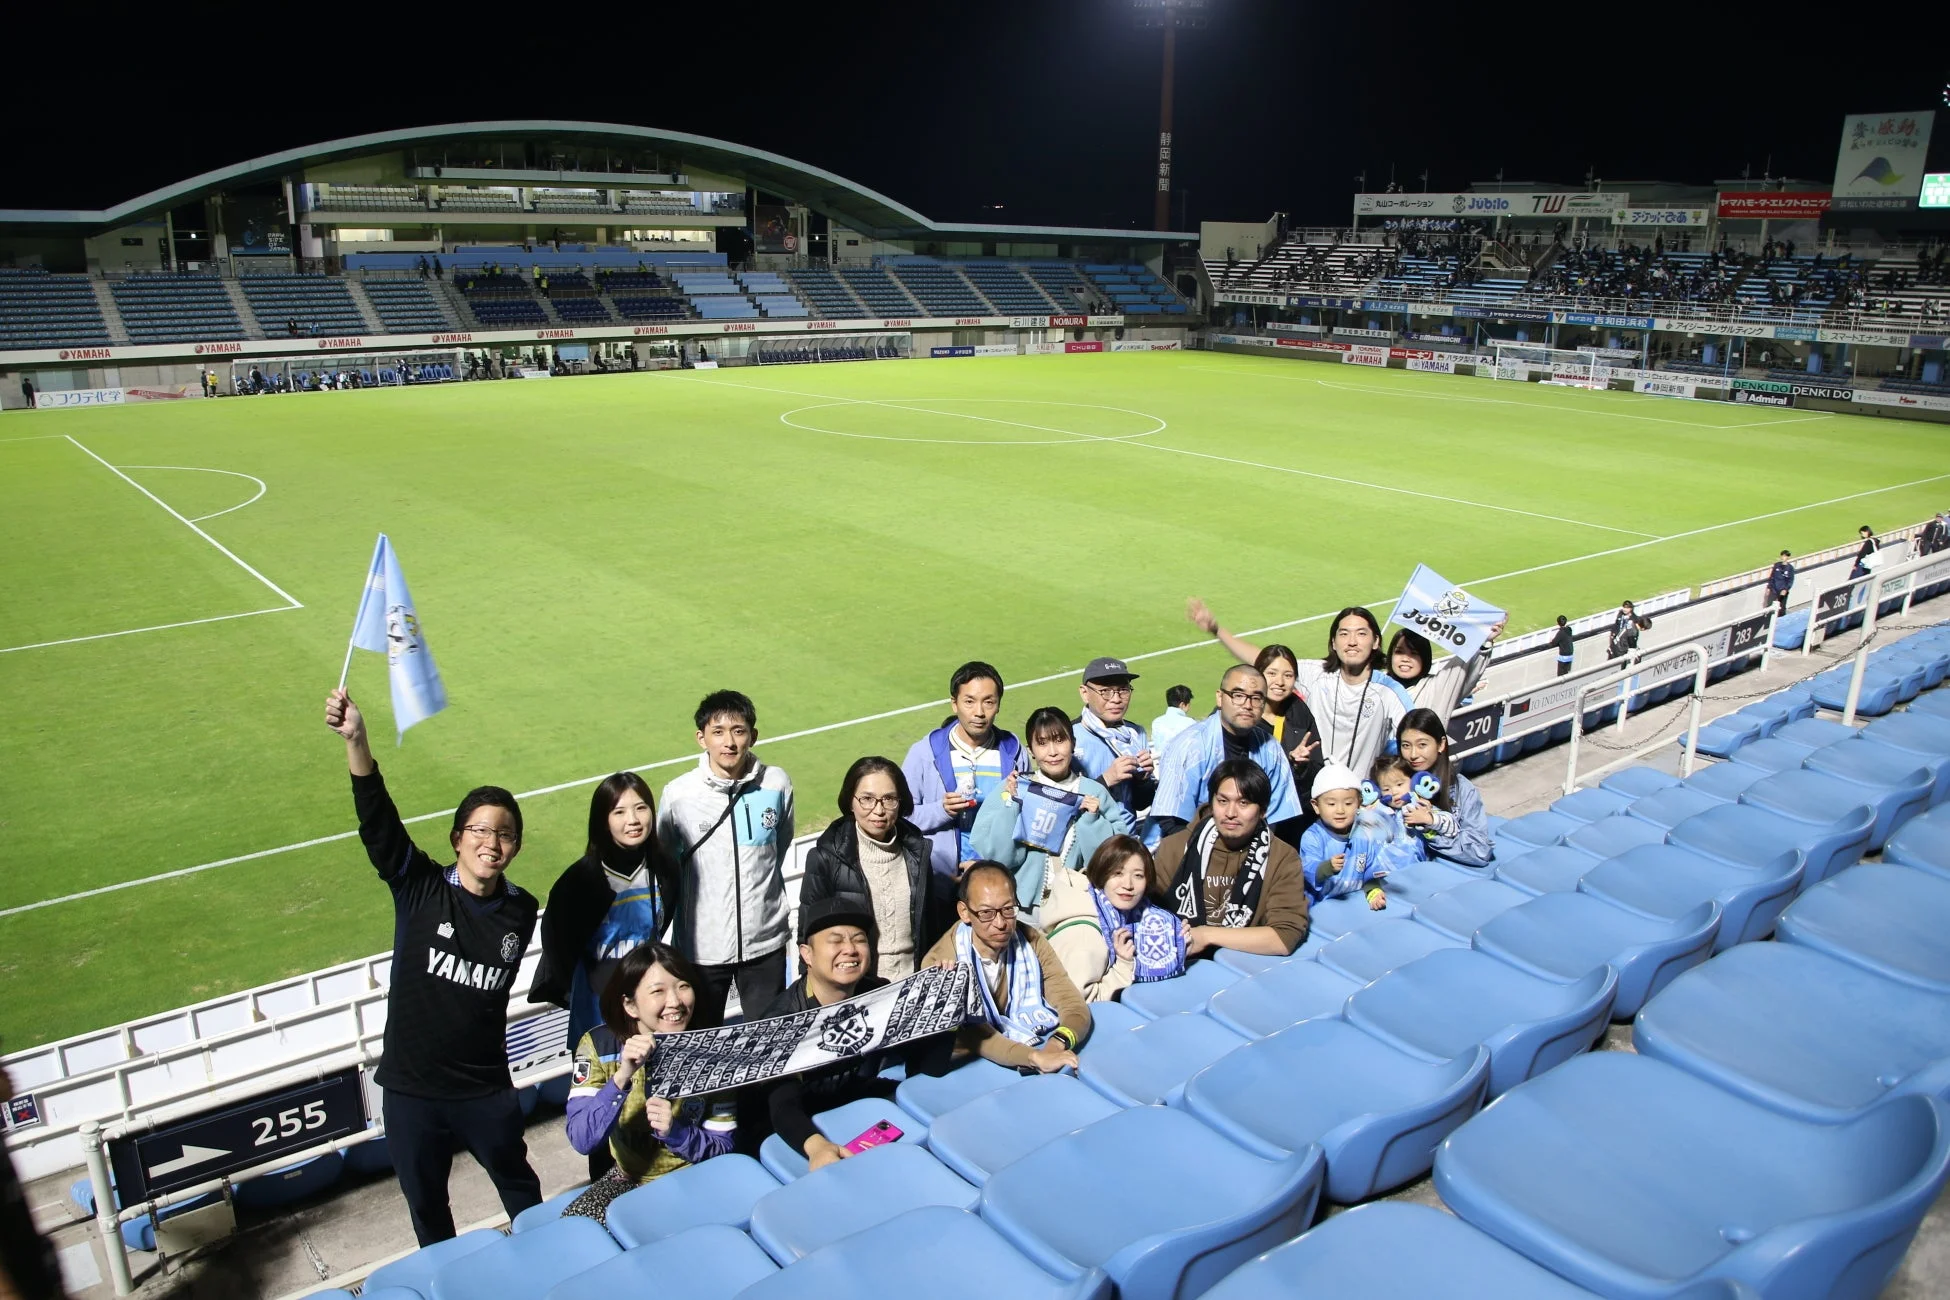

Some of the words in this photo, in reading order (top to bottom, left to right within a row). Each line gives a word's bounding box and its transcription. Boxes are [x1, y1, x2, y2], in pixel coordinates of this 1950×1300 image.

[1158, 132, 1172, 192] 静岡新聞
[1376, 200, 1434, 208] 丸山コーポレーション
[1632, 211, 1688, 224] チケットぴあ
[730, 322, 755, 331] YAMAHA
[813, 321, 837, 329] YAMAHA
[889, 319, 912, 327] YAMAHA
[960, 318, 981, 326] YAMAHA
[1053, 317, 1084, 326] NOMURA
[545, 329, 574, 338] YAMAHA
[640, 325, 668, 335] YAMAHA
[1675, 322, 1765, 335] アイジーコンサルティング
[327, 338, 362, 348] YAMAHA
[440, 333, 473, 343] YAMAHA
[1831, 332, 1906, 345] スマートエナジー磐田
[205, 343, 242, 353] YAMAHA
[70, 349, 111, 360] YAMAHA
[1355, 354, 1382, 366] YAMAHA
[1405, 350, 1432, 361] トーキン
[1421, 360, 1450, 372] YAMAHA
[1652, 383, 1685, 394] 静岡新聞
[1732, 381, 1769, 391] DENKI
[1771, 384, 1789, 393] DO
[1792, 386, 1830, 398] DENKI
[1833, 390, 1852, 400] DO
[1748, 393, 1788, 405] Admiral
[1833, 592, 1848, 609] 285
[1734, 628, 1753, 647] 283
[1465, 715, 1492, 741] 270
[1031, 807, 1058, 834] 50
[1244, 837, 1260, 867] IWATA
[427, 946, 510, 991] YAMAHA
[251, 1099, 328, 1147] 255
